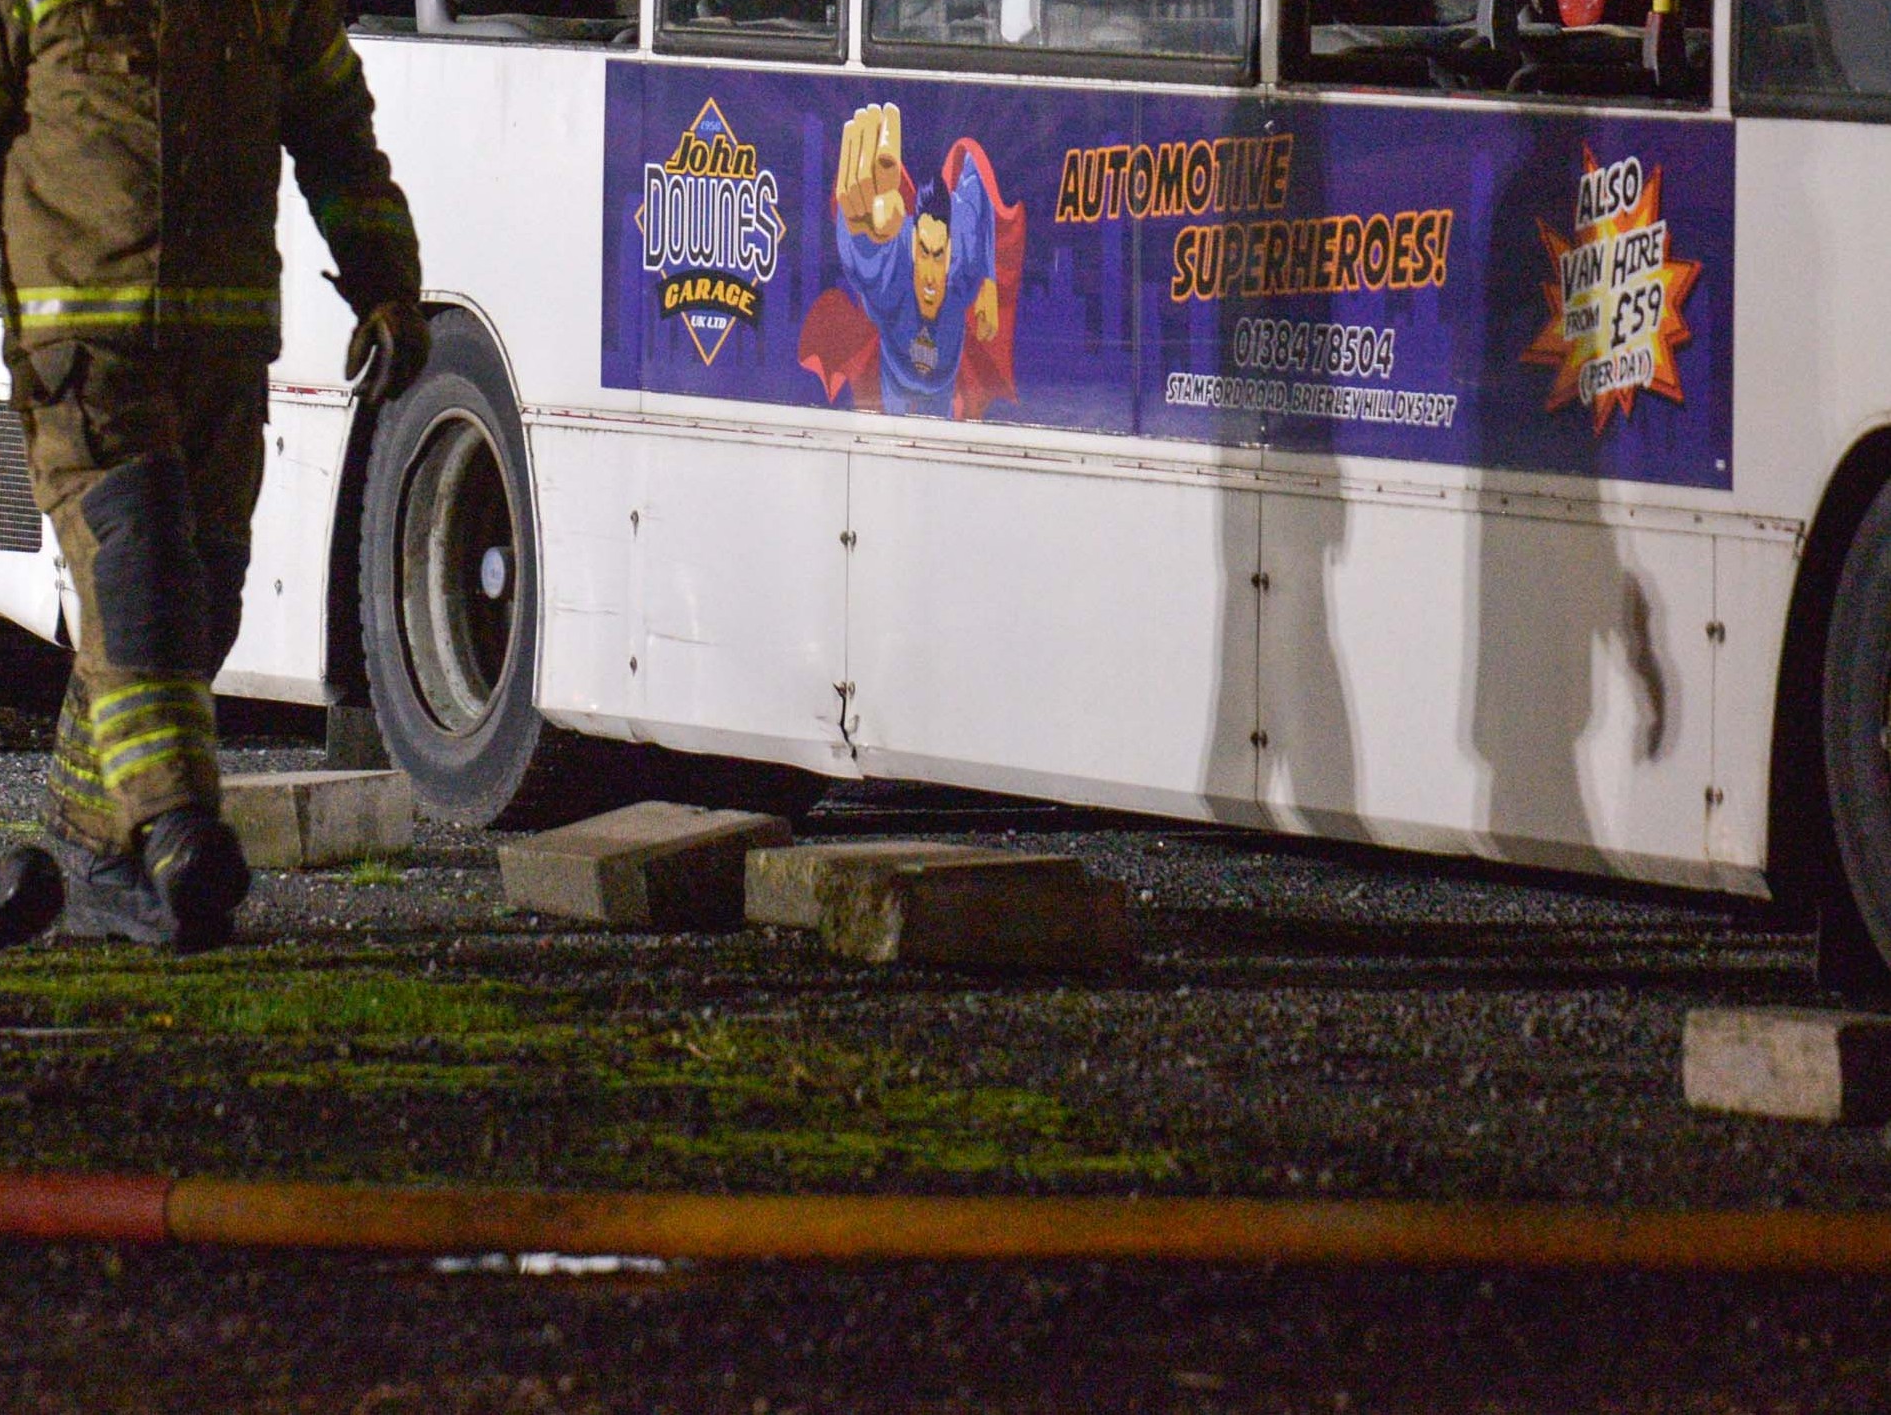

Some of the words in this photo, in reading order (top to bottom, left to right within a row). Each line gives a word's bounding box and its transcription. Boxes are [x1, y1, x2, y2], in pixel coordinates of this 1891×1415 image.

[664, 131, 757, 179] John
[1055, 134, 1294, 223] AUTOMOTIVE
[1575, 155, 1643, 232] ALSO
[1170, 208, 1453, 303] SUPERHEROES!
[1559, 240, 1606, 302] VAN
[1609, 218, 1667, 290] HIRE
[663, 277, 757, 317] GARAGE
[690, 315, 706, 329] UK
[707, 315, 727, 330] LTD
[1564, 301, 1602, 341] FROM
[1609, 281, 1665, 352] £59
[1234, 317, 1309, 371] 01384
[1311, 322, 1396, 380] 78504
[1579, 358, 1614, 407] (PER
[1617, 346, 1654, 390] DAY)
[1165, 372, 1243, 409] STAMFORD
[1290, 381, 1361, 420] BRIERLEY
[1360, 387, 1394, 420] HILL
[1394, 390, 1424, 425] DY5
[1424, 393, 1458, 429] 2PT
